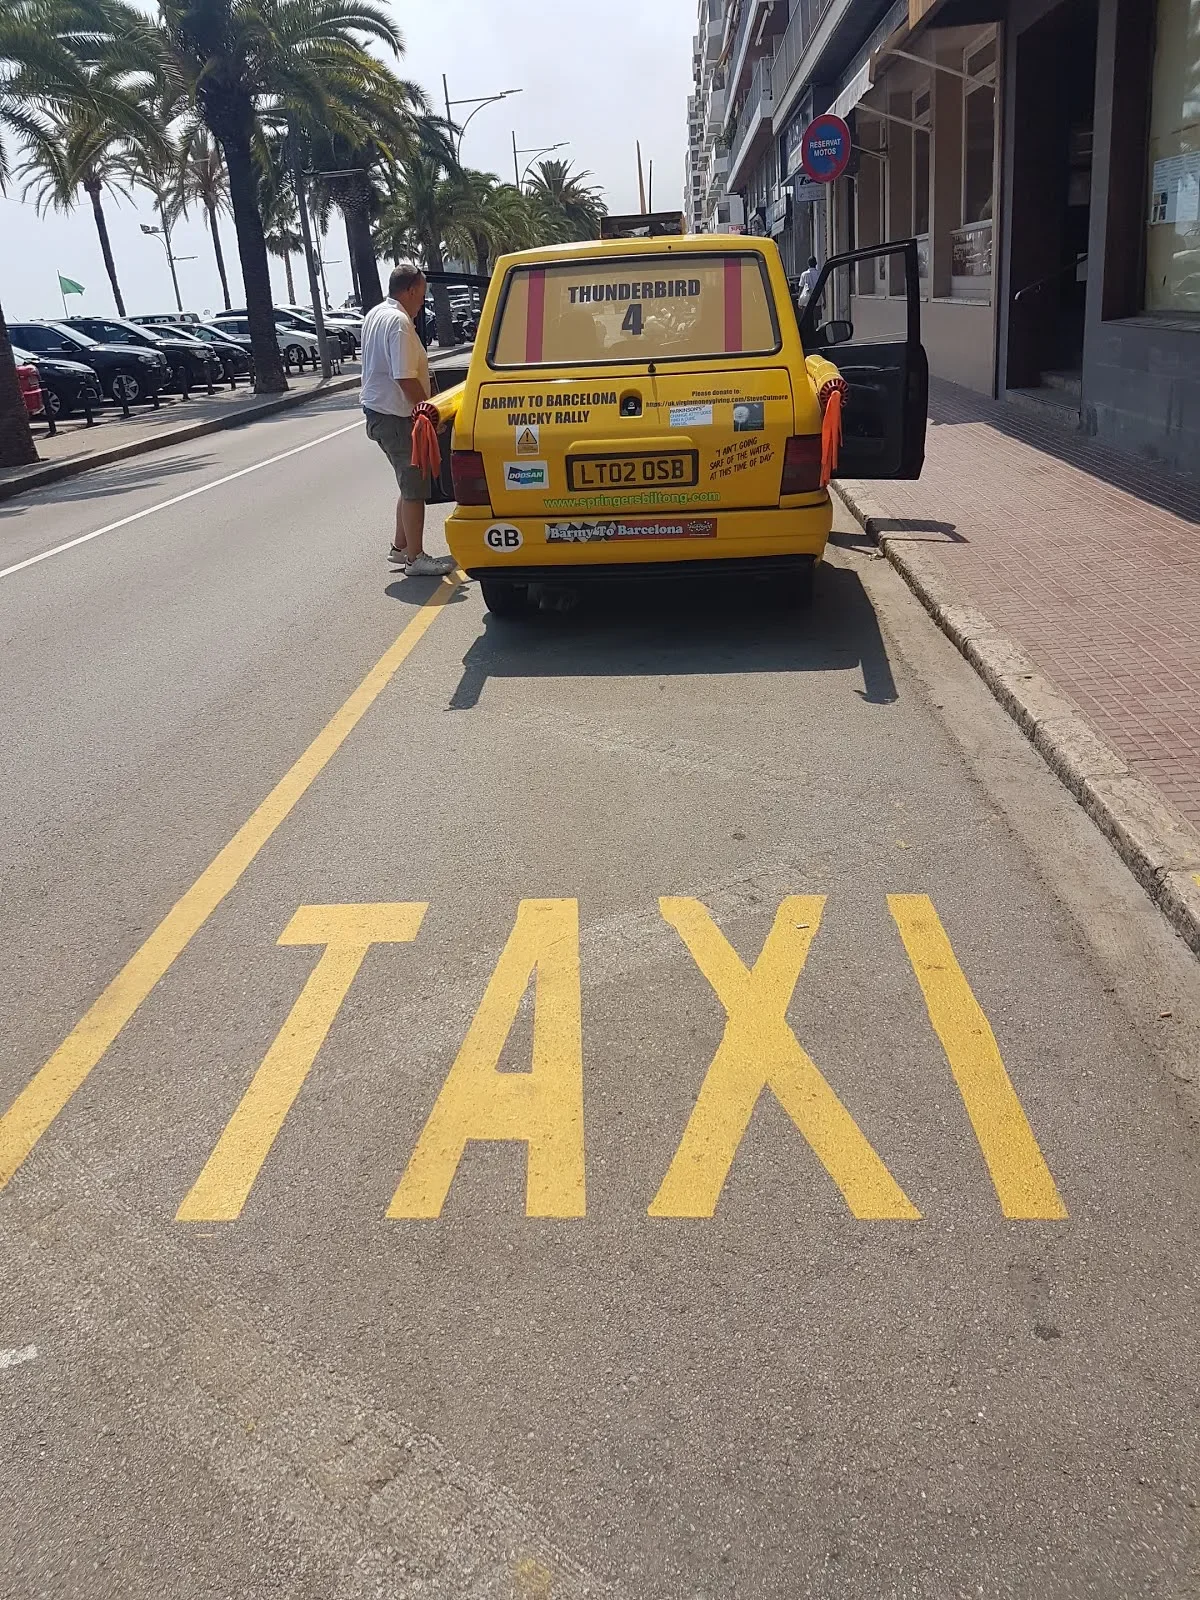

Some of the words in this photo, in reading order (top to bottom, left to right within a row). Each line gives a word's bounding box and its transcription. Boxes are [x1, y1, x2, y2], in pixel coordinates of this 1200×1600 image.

[809, 138, 842, 149] RESERVAT
[813, 147, 837, 157] MOTOS
[568, 279, 701, 303] THUNDERBIRD
[621, 303, 645, 336] 4
[482, 396, 525, 410] BARMY
[528, 394, 543, 408] TO
[546, 391, 617, 407] BARCELONA
[691, 389, 712, 397] Please
[712, 388, 732, 397] donate
[508, 411, 552, 425] WACKY
[555, 410, 590, 424] RALLY
[738, 436, 758, 450] GOING
[709, 458, 724, 471] SARF
[726, 454, 735, 465] OF
[736, 450, 747, 461] THE
[749, 442, 771, 456] WATER
[508, 471, 543, 480] DOOSAN
[709, 471, 717, 481] AT
[719, 466, 732, 478] THIS
[733, 461, 747, 472] TIME
[749, 457, 757, 468] OF
[544, 491, 721, 508] www.springersbiltong.com
[487, 528, 520, 547] GB
[550, 527, 593, 541] Barmy
[596, 524, 615, 538] To
[617, 522, 683, 537] Barcelona
[177, 893, 1069, 1221] TAXI
